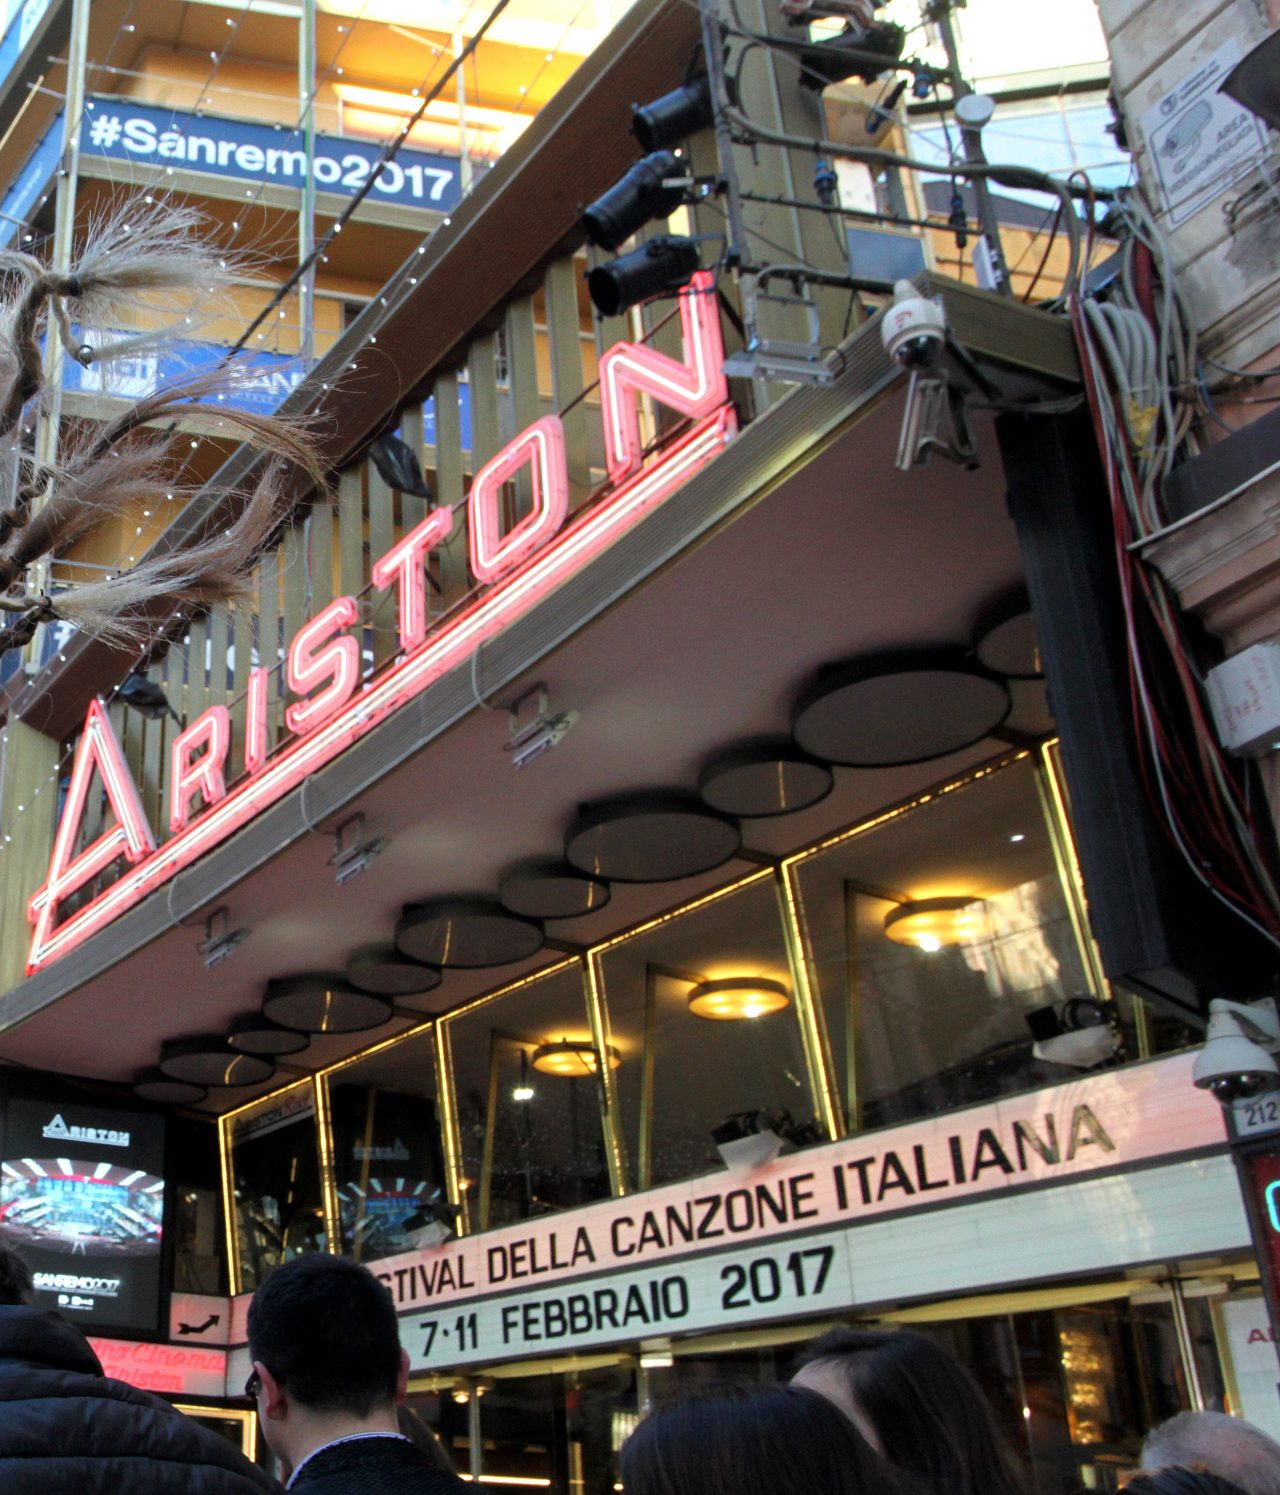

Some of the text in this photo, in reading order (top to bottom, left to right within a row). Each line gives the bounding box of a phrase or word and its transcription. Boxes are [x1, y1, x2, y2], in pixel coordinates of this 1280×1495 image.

[89, 114, 453, 201] #Sanremo2017
[27, 270, 734, 974] ARISTON
[487, 1226, 596, 1284] DELLA
[611, 1172, 819, 1257] CANZONE
[832, 1103, 1116, 1210] ITALIANA
[502, 1275, 690, 1344] FEBBRAIO
[720, 1245, 835, 1310] 2017
[131, 1343, 226, 1373] Cinema
